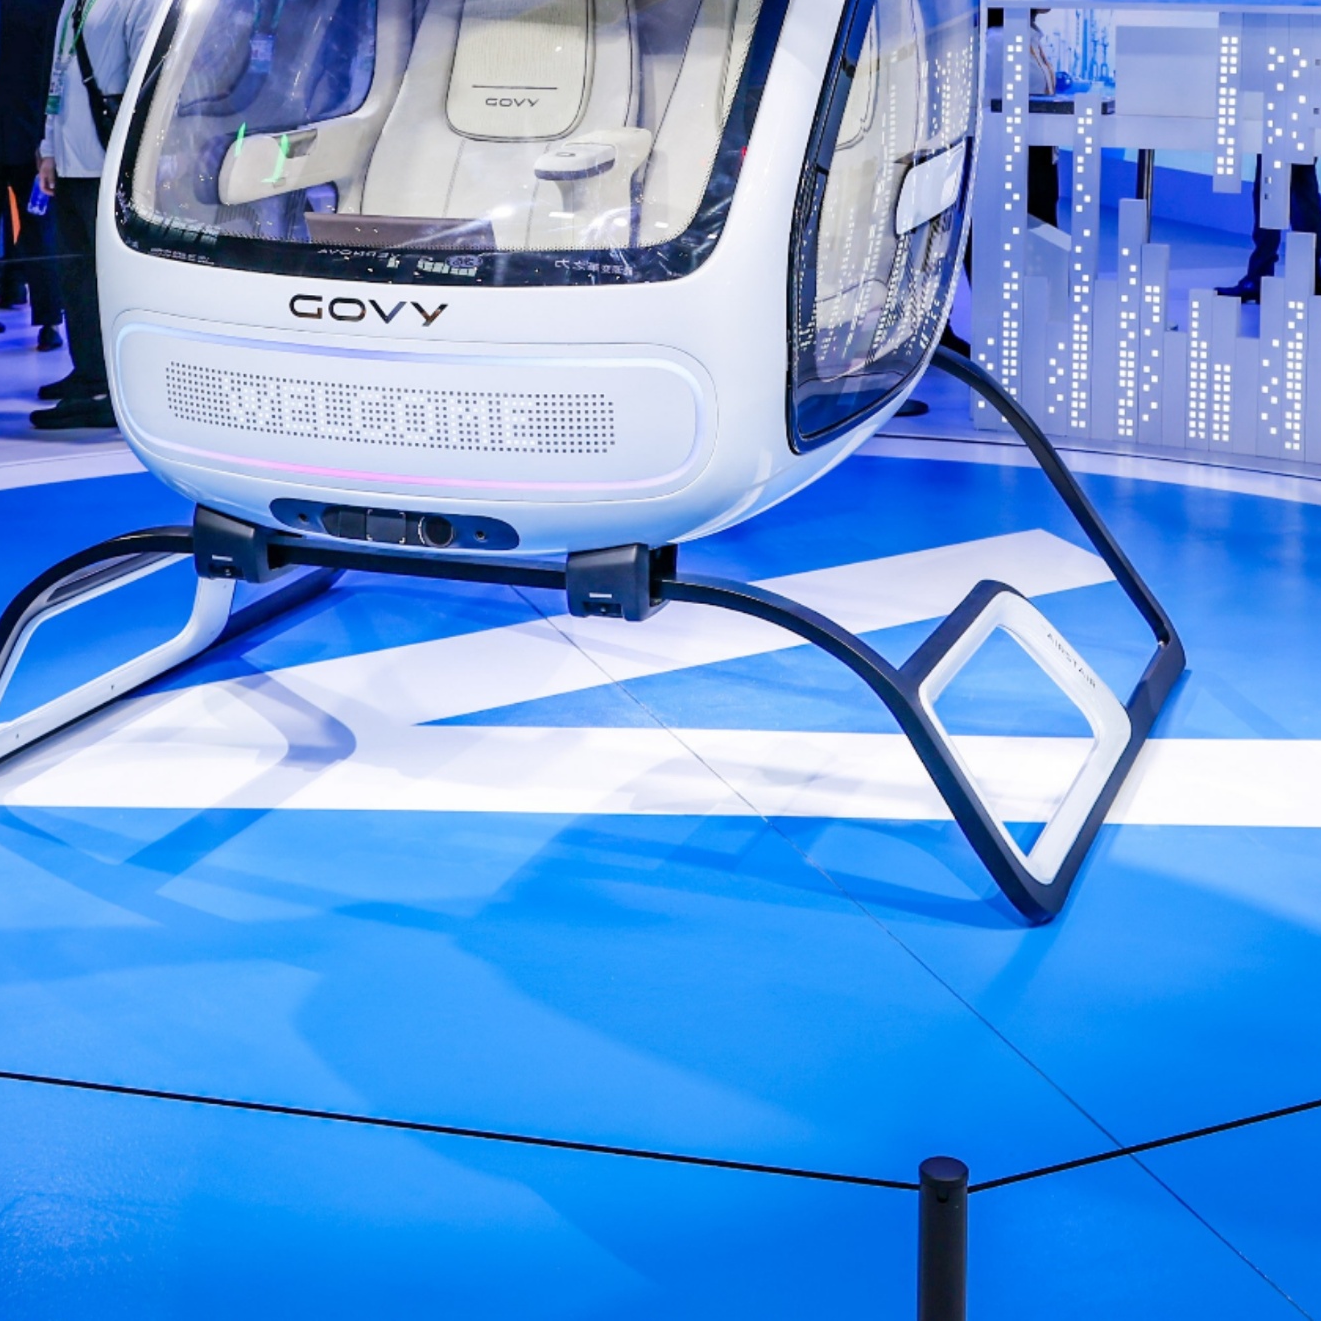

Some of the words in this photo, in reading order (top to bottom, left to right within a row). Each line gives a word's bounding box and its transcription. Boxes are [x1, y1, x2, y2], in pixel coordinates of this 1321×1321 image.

[485, 97, 539, 107] GOVY
[288, 293, 449, 327] GOVY
[223, 377, 539, 447] WELCOME
